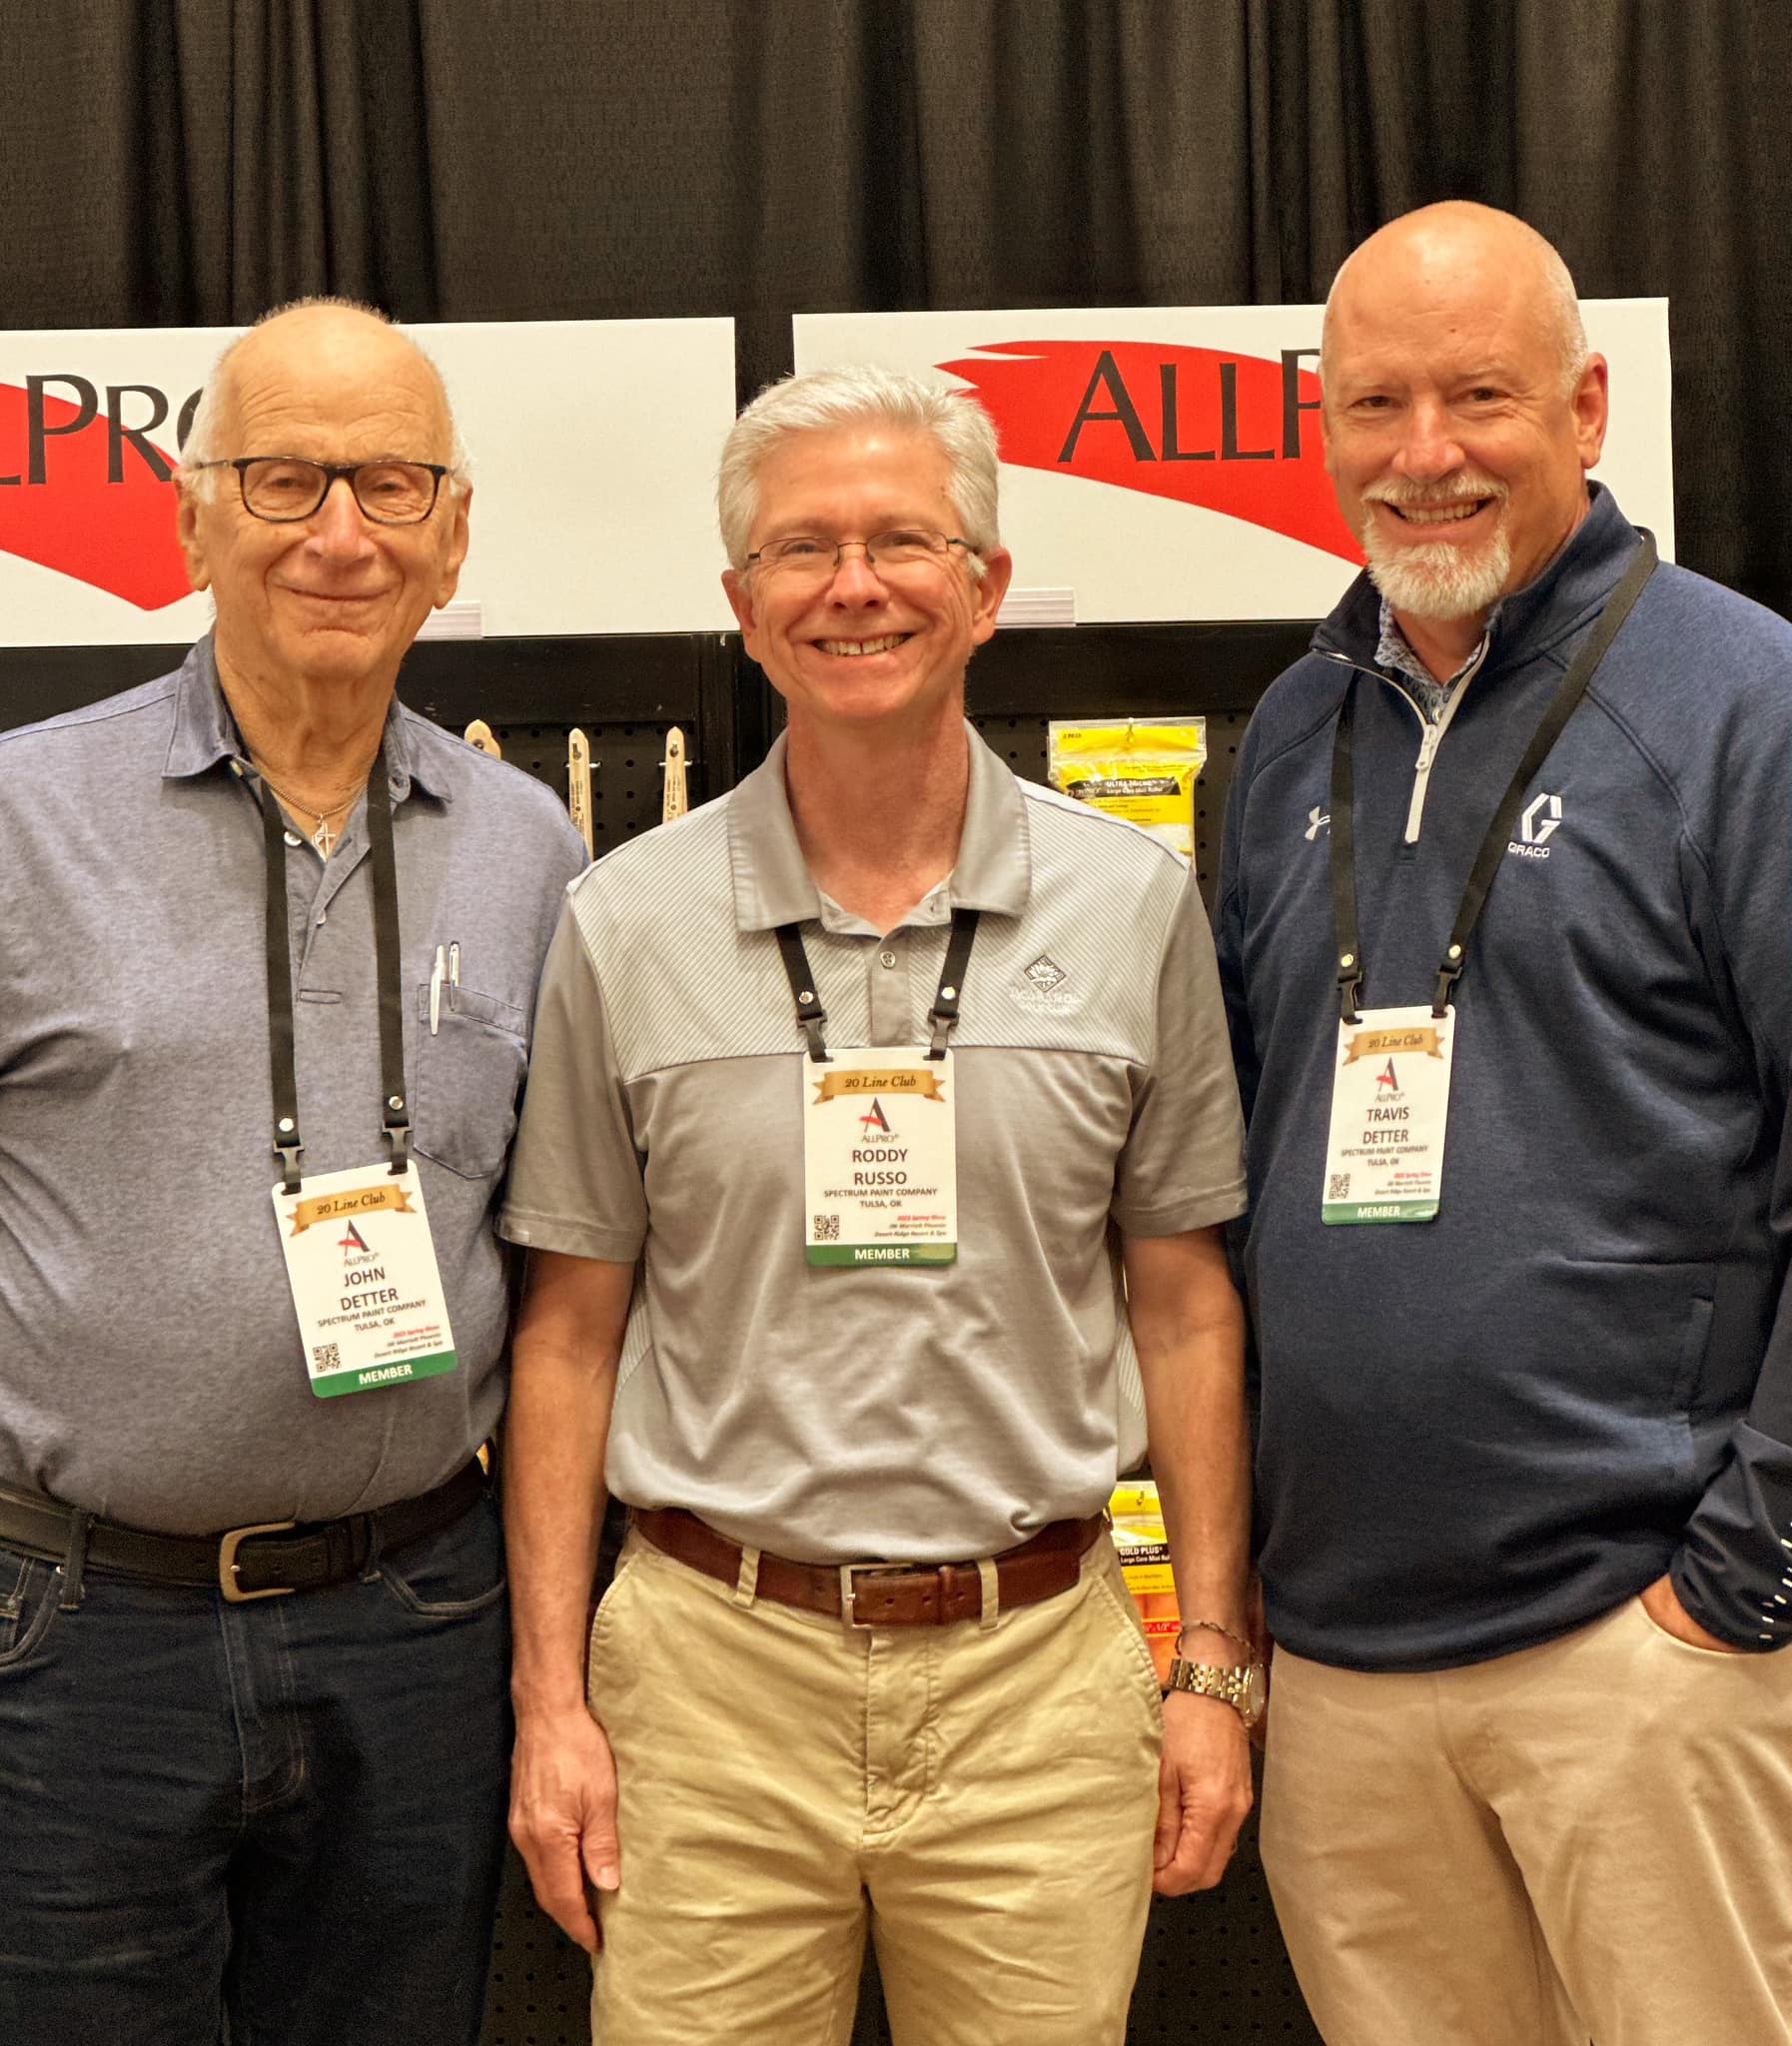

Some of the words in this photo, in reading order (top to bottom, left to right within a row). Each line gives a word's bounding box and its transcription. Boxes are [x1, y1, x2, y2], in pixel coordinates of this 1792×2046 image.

[0, 374, 204, 486] PR
[1507, 841, 1550, 858] GRACO
[1381, 1036, 1400, 1048] Line
[1403, 1034, 1423, 1046] Club
[844, 1078, 860, 1088] 20
[862, 1077, 888, 1088] Line
[891, 1075, 916, 1087] Club
[1366, 1106, 1409, 1122] TRAVIS
[1362, 1129, 1408, 1145] DETTER
[852, 1149, 908, 1163] RODDY
[854, 1171, 907, 1186] RUSSO
[317, 1204, 331, 1215] 20
[334, 1200, 359, 1212] Line
[361, 1192, 386, 1206] Club
[1357, 1206, 1400, 1218] MEMBER
[855, 1248, 910, 1260] MEMBER
[344, 1267, 386, 1288] JOHN
[341, 1288, 400, 1311] DETTER
[318, 1312, 361, 1328] SPECTRUM
[362, 1307, 386, 1320] PAINT
[387, 1300, 427, 1314] COMPANY
[355, 1321, 382, 1332] TULSA,
[359, 1364, 413, 1385] MEMBER
[1120, 1546, 1140, 1556] GOLD
